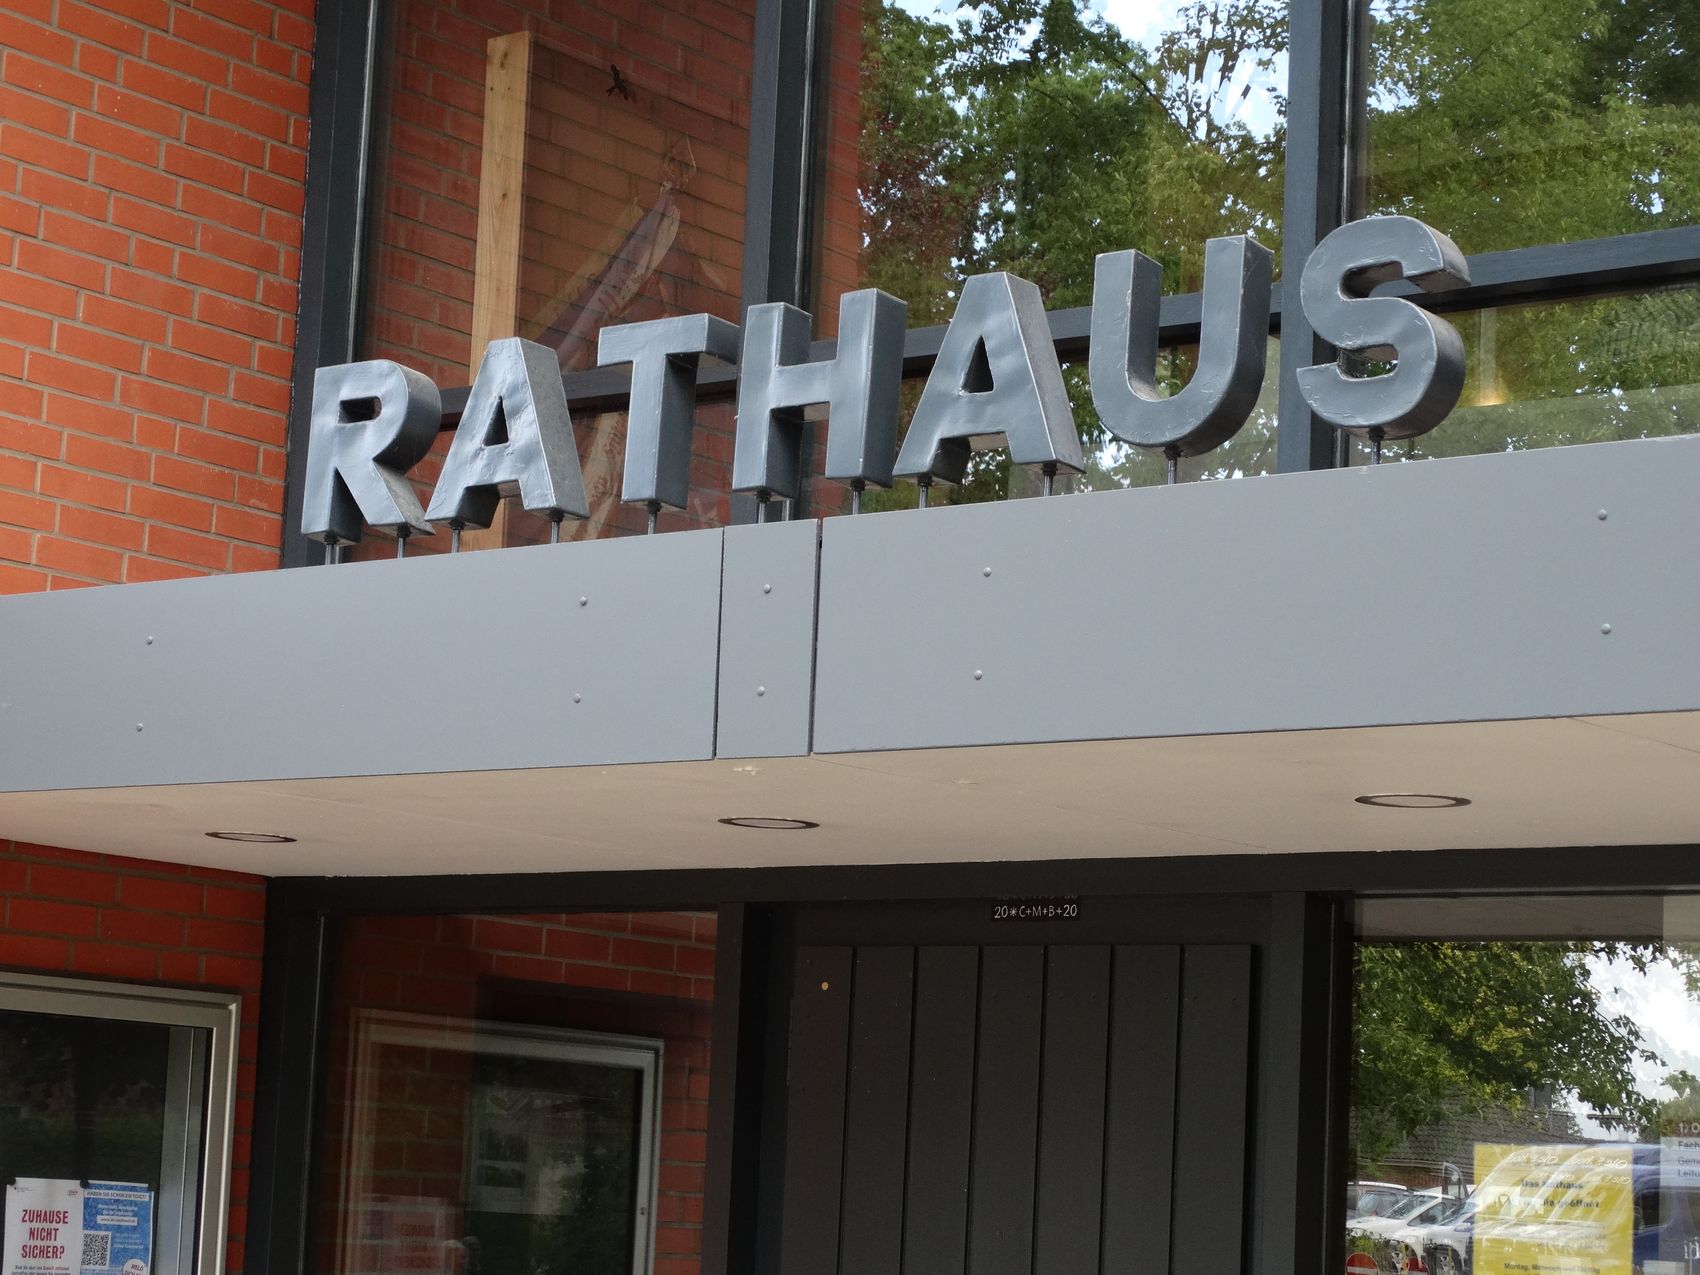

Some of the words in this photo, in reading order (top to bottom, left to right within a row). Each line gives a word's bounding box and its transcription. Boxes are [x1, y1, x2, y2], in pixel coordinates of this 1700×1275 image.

[301, 214, 1469, 543] RATHAUS
[21, 1209, 69, 1224] ZUHAUSE
[29, 1227, 59, 1241] NICHT
[21, 1244, 65, 1259] SICHER?
